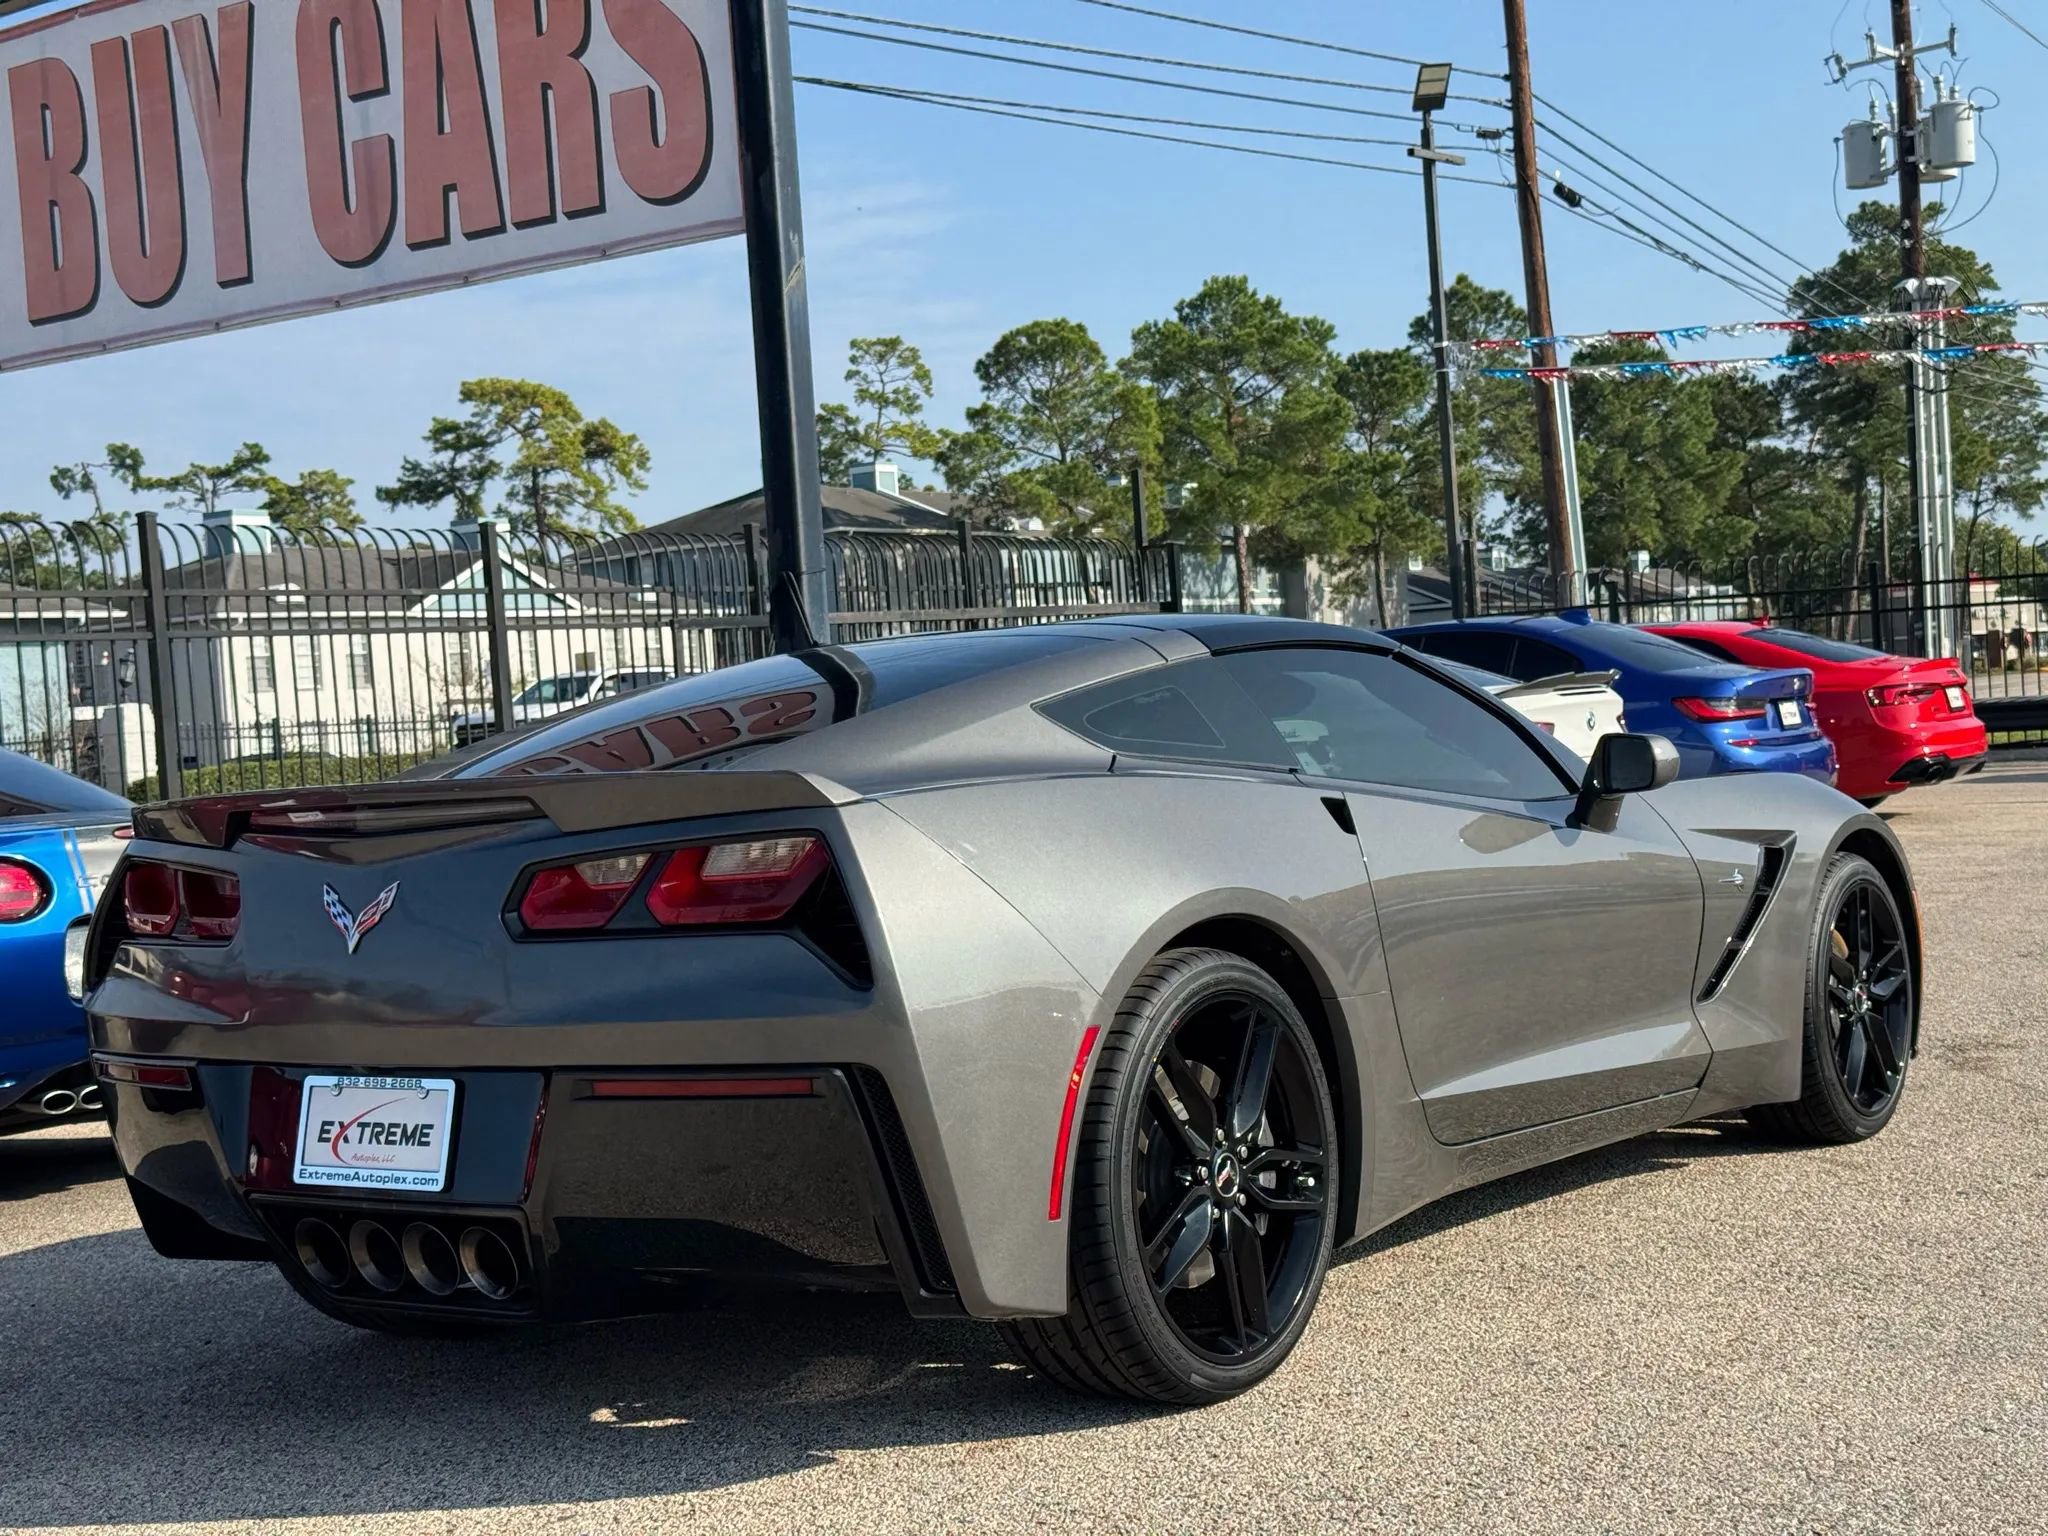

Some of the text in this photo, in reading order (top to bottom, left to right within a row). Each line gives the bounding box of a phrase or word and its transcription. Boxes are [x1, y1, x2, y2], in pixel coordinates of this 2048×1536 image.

[8, 0, 713, 326] BUY CARS
[337, 1077, 422, 1089] 832-698-2668
[317, 1120, 435, 1147] EXTREME
[299, 1168, 439, 1187] ExtremeAutoplex.com
